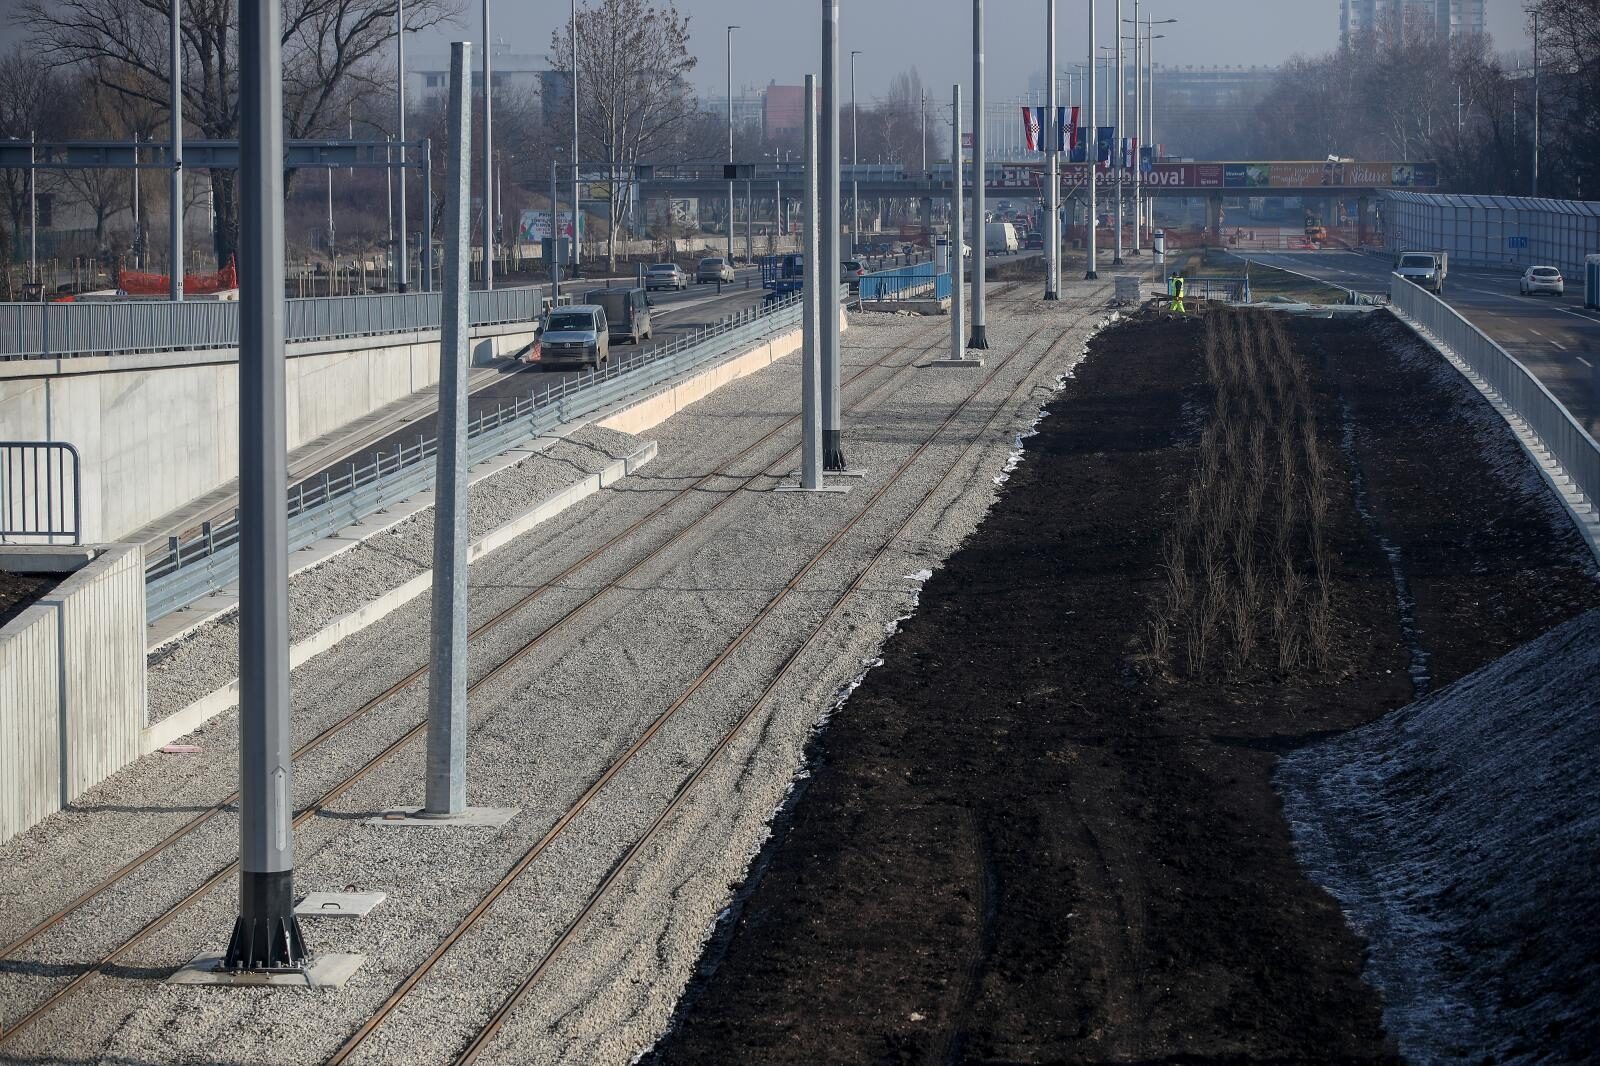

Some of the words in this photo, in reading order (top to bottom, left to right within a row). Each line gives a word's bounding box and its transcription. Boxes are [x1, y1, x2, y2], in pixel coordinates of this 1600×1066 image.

[1056, 166, 1088, 185] ači
[1095, 167, 1115, 185] od
[1121, 167, 1185, 185] bolova!
